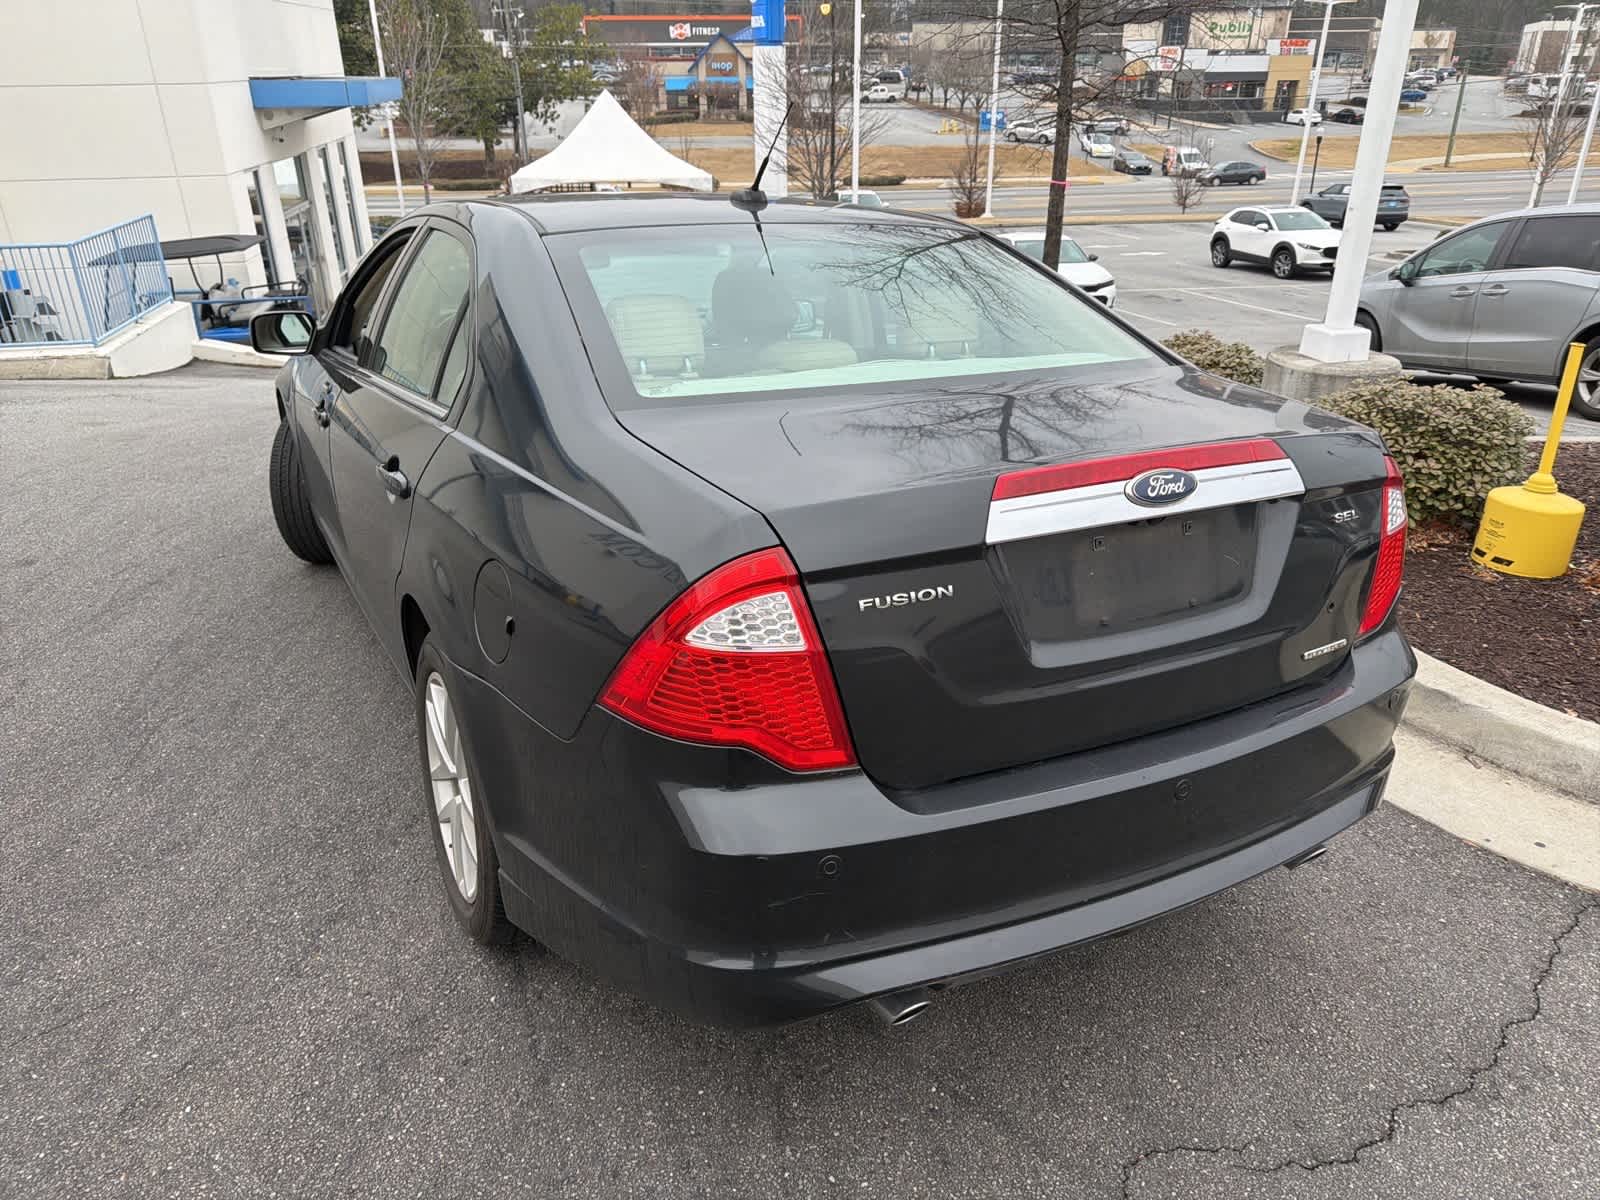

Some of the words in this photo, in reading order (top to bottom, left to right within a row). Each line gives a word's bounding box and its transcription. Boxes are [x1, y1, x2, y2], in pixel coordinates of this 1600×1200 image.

[1147, 473, 1186, 497] Ford
[1334, 509, 1360, 524] SEL
[858, 584, 953, 612] FUSION
